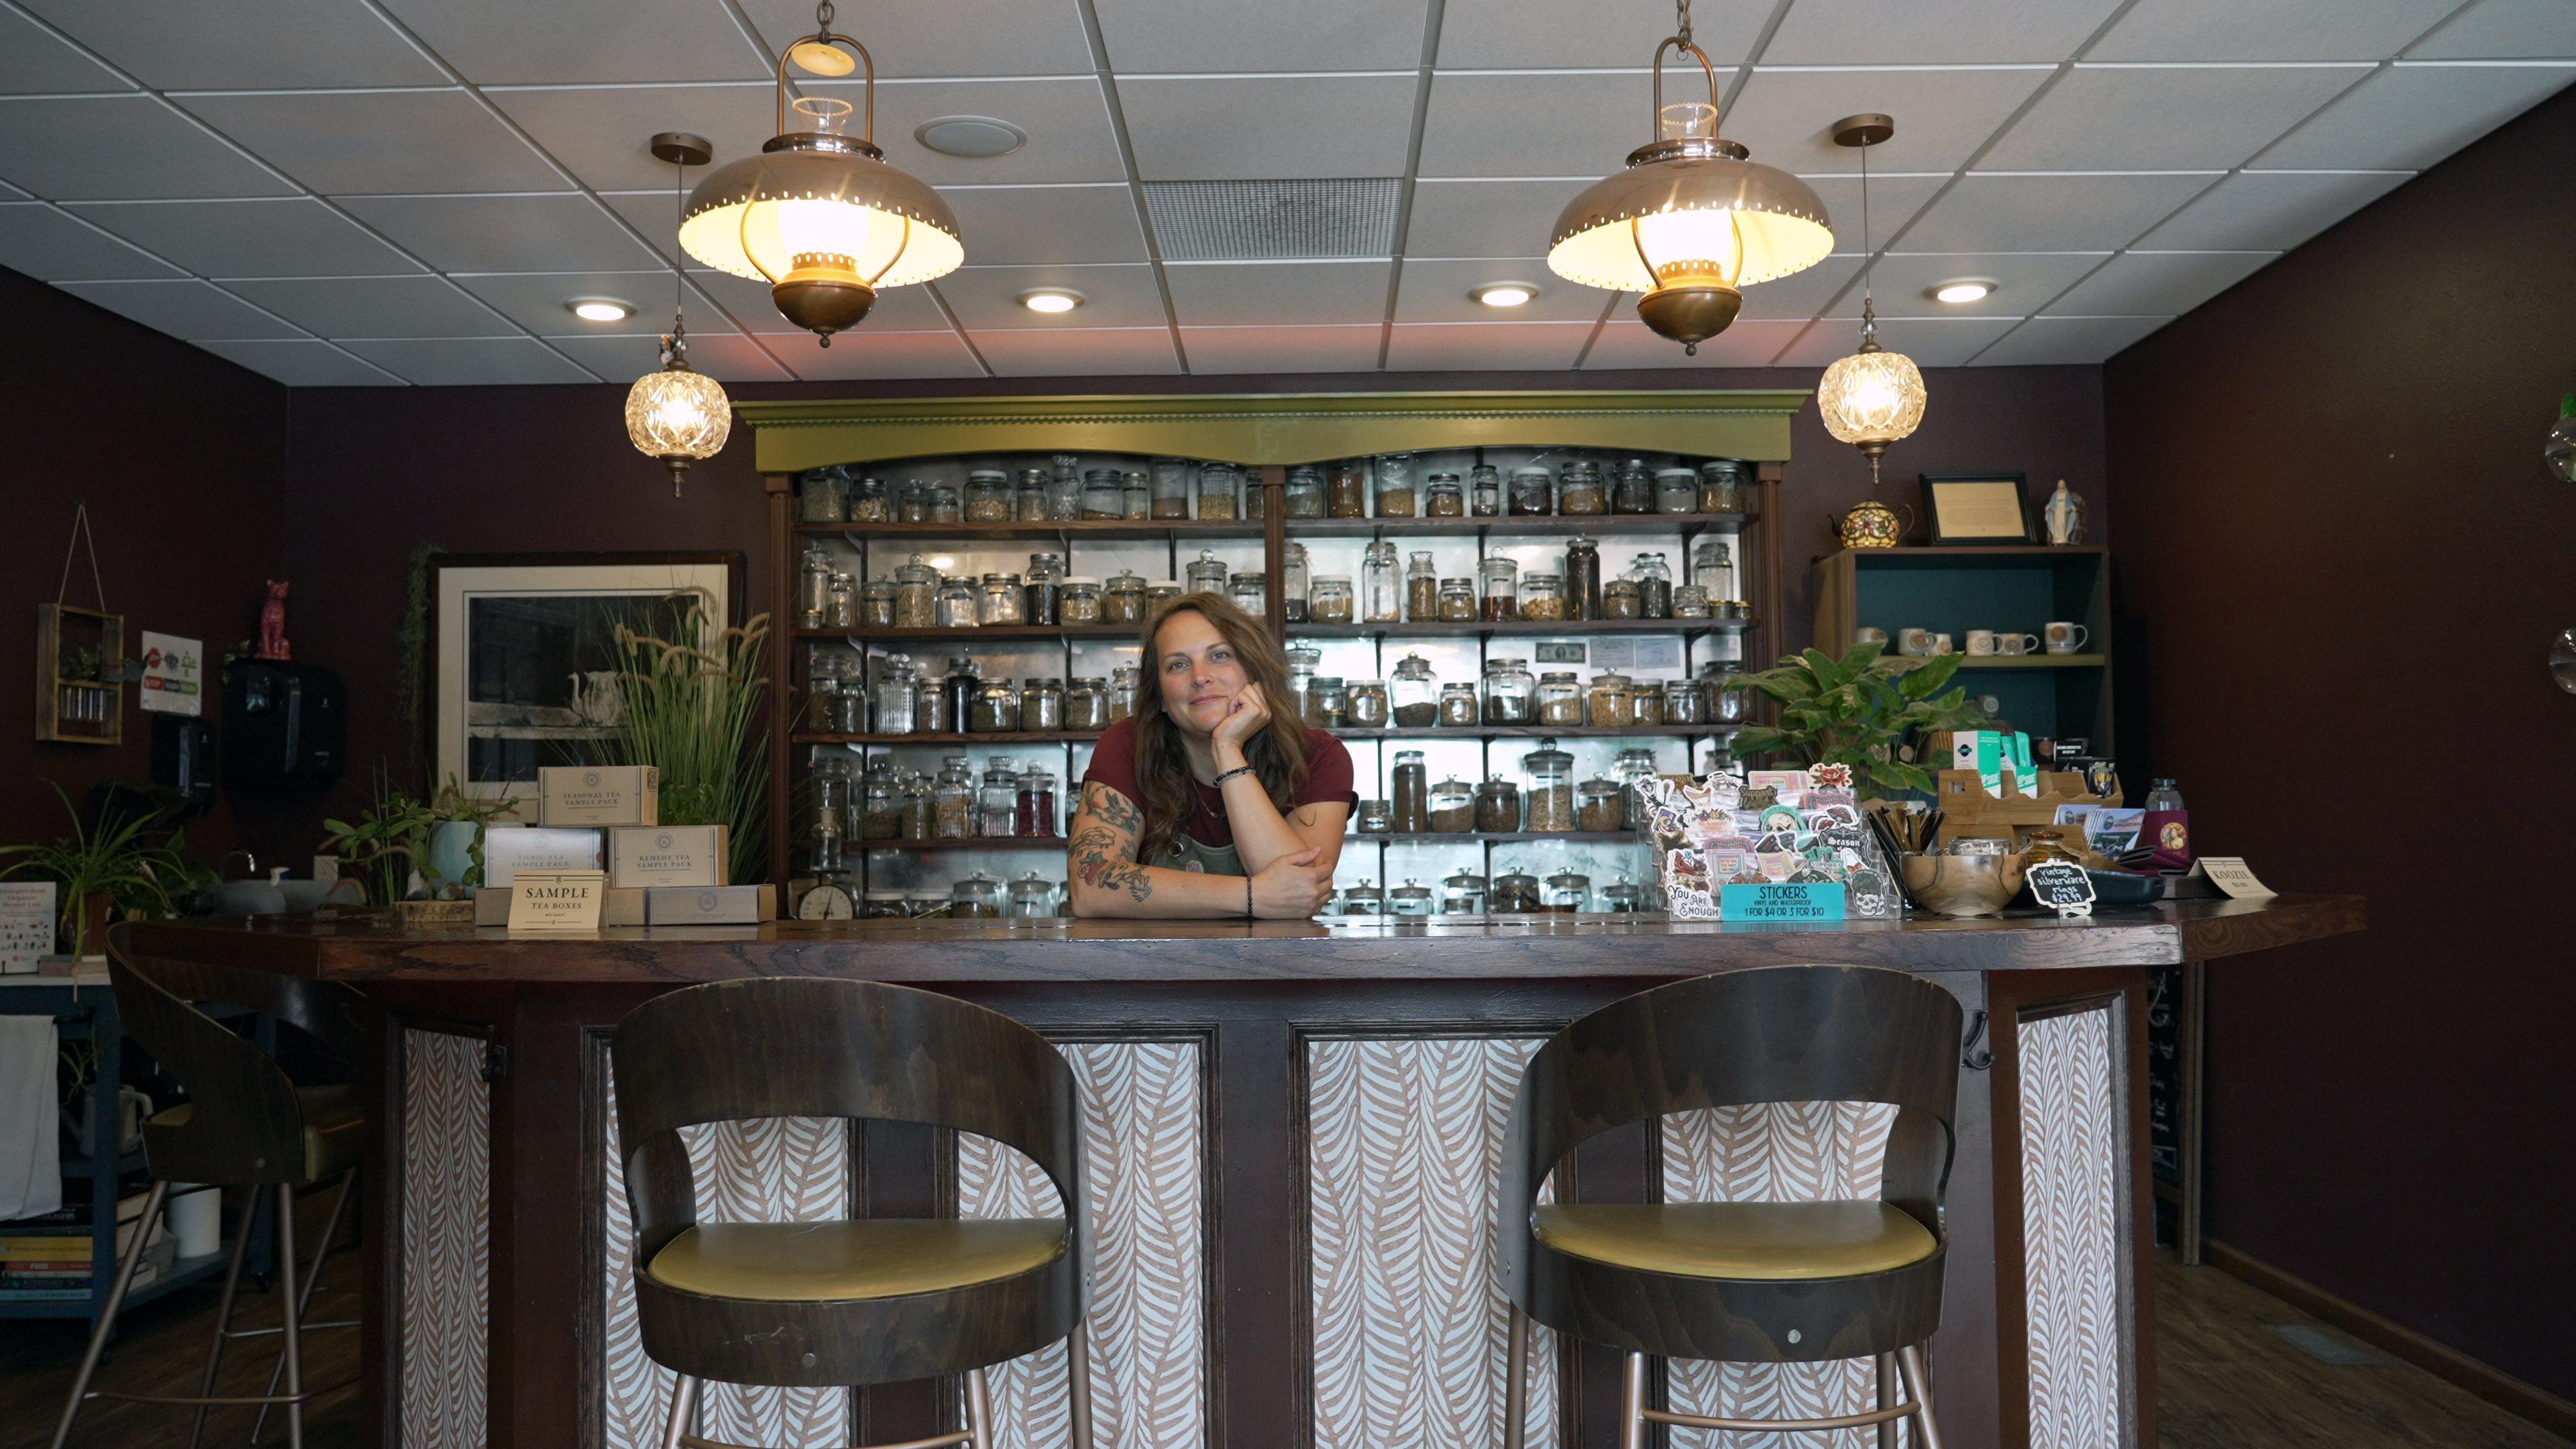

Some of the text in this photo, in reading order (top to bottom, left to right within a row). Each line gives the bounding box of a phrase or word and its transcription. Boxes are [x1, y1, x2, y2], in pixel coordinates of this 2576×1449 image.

[1827, 837, 1860, 847] Season
[2039, 867, 2072, 878] vintage
[2212, 870, 2251, 879] KOOZIE
[2037, 876, 2085, 885] silverware
[525, 887, 590, 898] SAMPLE
[1759, 886, 1808, 900] STICKERS
[2051, 885, 2078, 895] rings
[2051, 893, 2082, 902] $29.99
[1745, 907, 1824, 917] 1 FOR $4 OR 3 FOR $10
